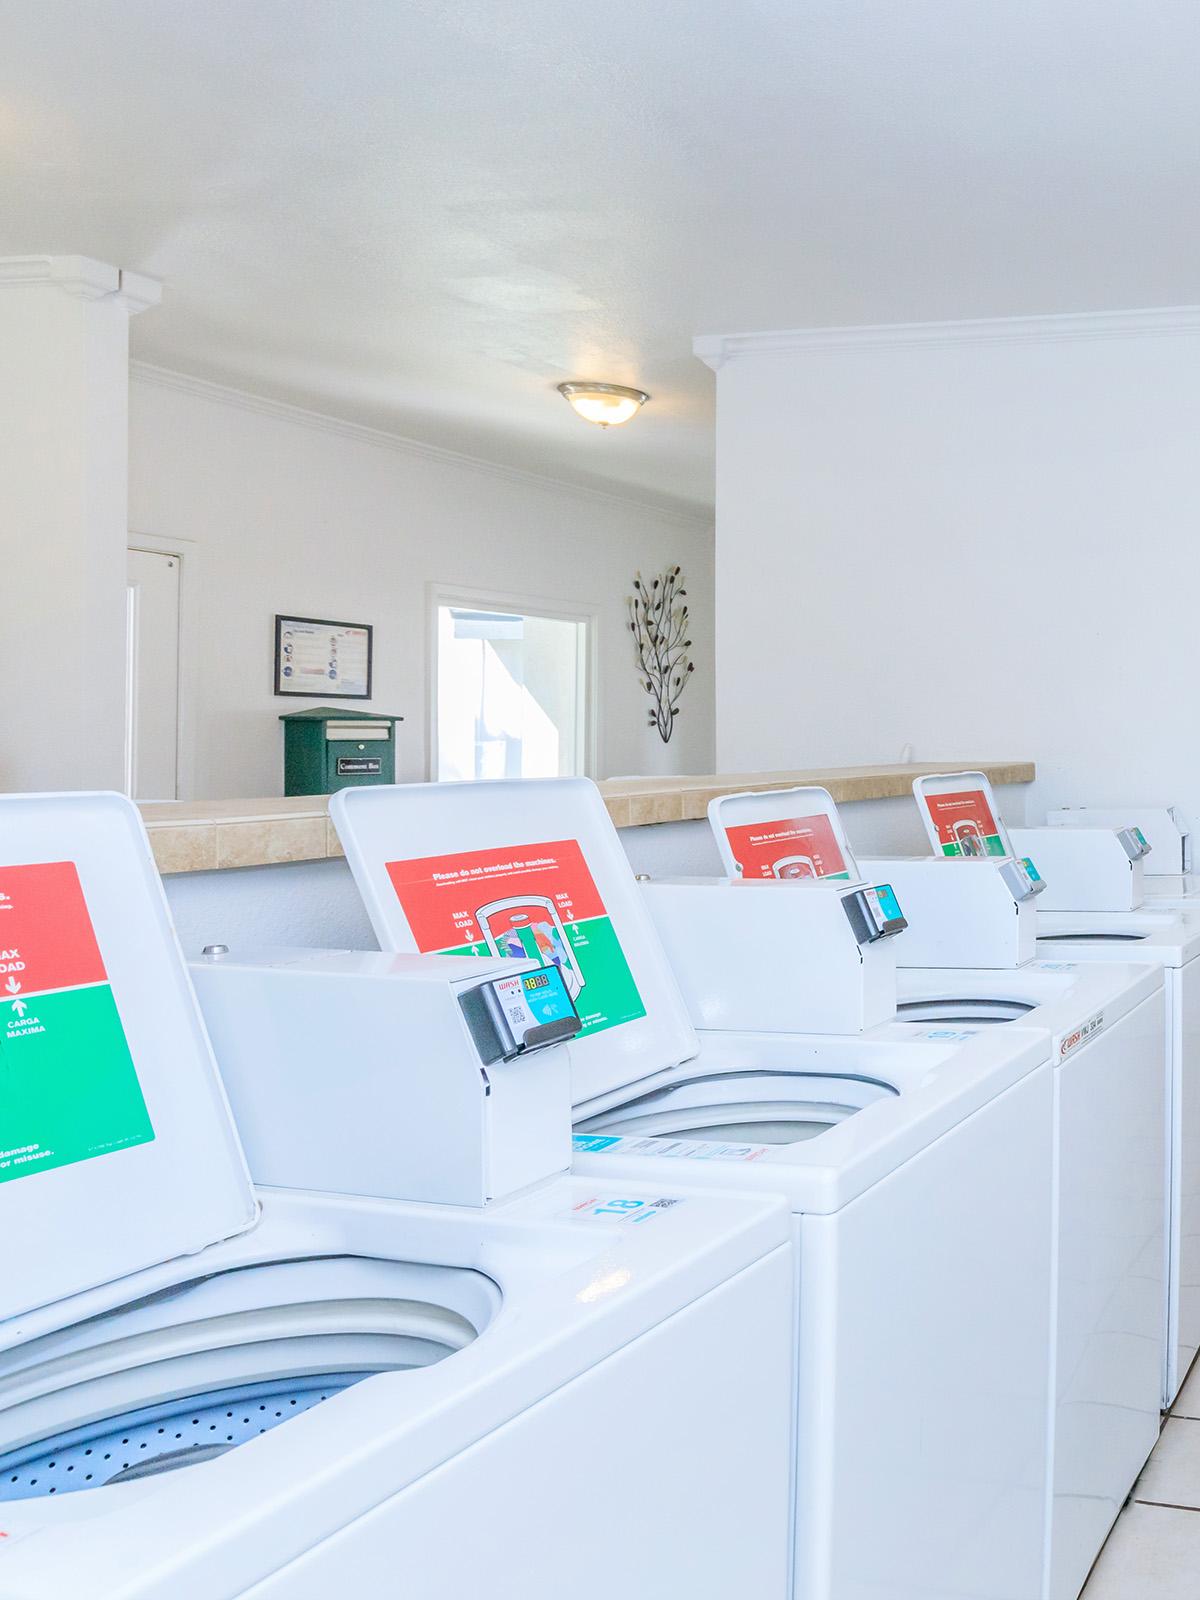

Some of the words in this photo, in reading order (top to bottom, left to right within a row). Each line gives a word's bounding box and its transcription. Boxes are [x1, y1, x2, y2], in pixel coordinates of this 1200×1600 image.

[432, 871, 459, 881] Please
[460, 869, 469, 877] do
[484, 863, 513, 873] overload
[555, 893, 569, 901] MAX
[558, 899, 573, 909] LOAD
[452, 910, 469, 920] MAX
[454, 918, 473, 929] LOAD
[498, 979, 520, 991] WASH
[7, 1017, 40, 1029] CARGA
[6, 1025, 46, 1038] MAXIMA
[0, 1160, 11, 1169] or
[14, 1150, 55, 1165] misuse.
[592, 1199, 644, 1215] 18
